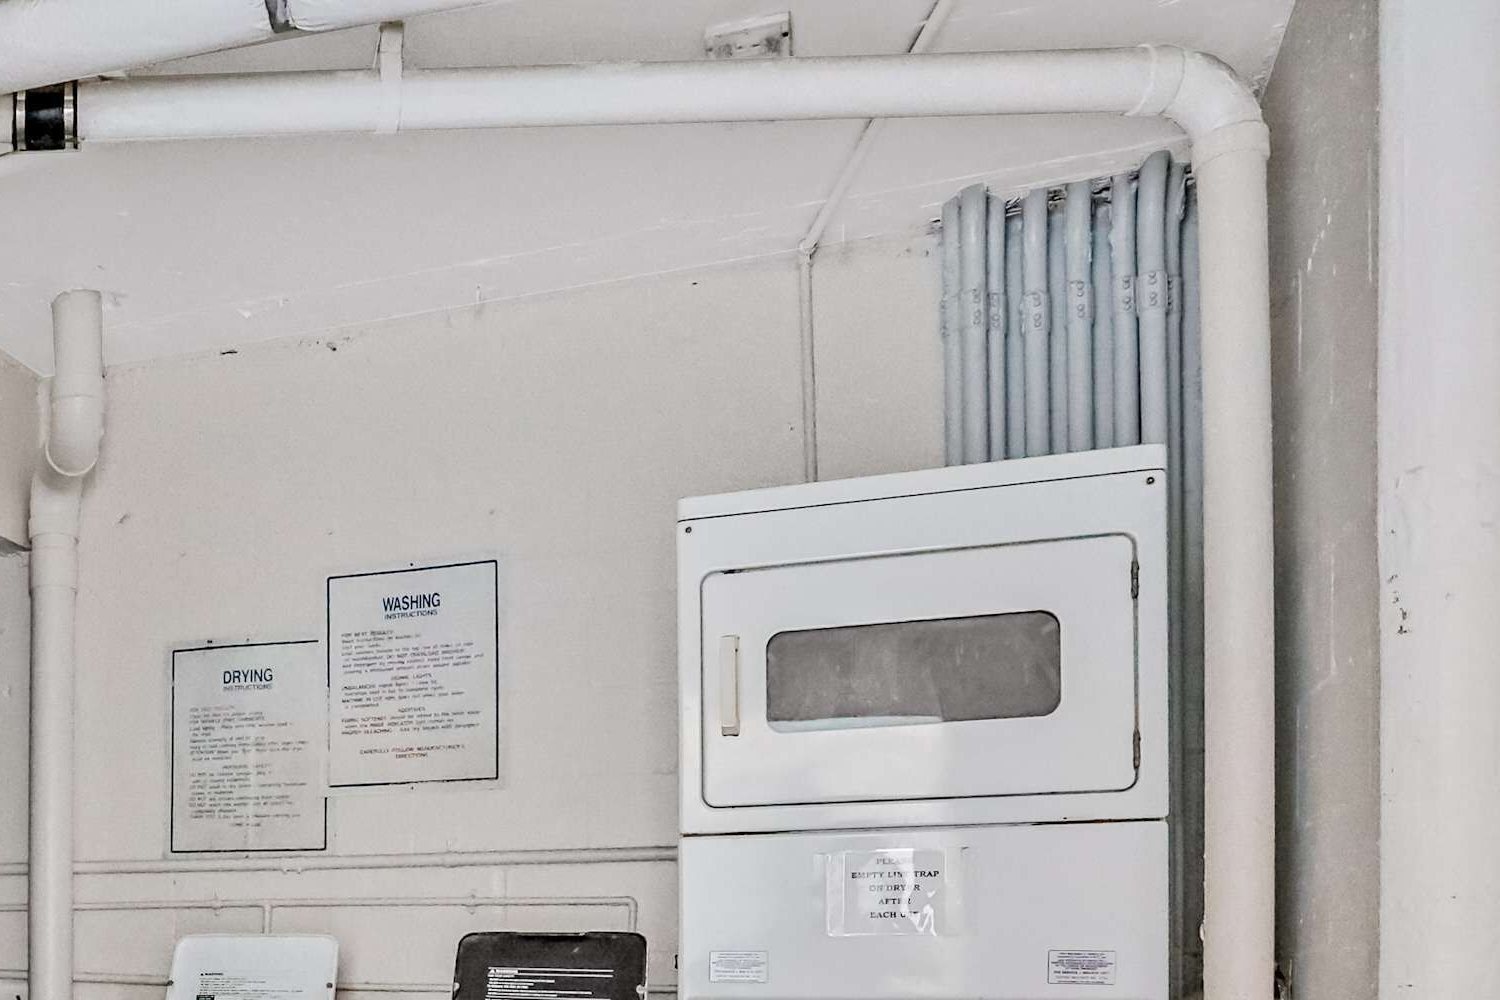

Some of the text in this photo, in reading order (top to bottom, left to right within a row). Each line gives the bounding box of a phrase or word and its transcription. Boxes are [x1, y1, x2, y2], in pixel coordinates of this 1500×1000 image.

[382, 592, 441, 612] WASHING
[384, 609, 438, 620] INSTRUCTIONS
[223, 668, 274, 685] DRYING
[887, 871, 906, 879] LIN
[913, 870, 940, 878] TRAP
[886, 884, 921, 892] DRYR
